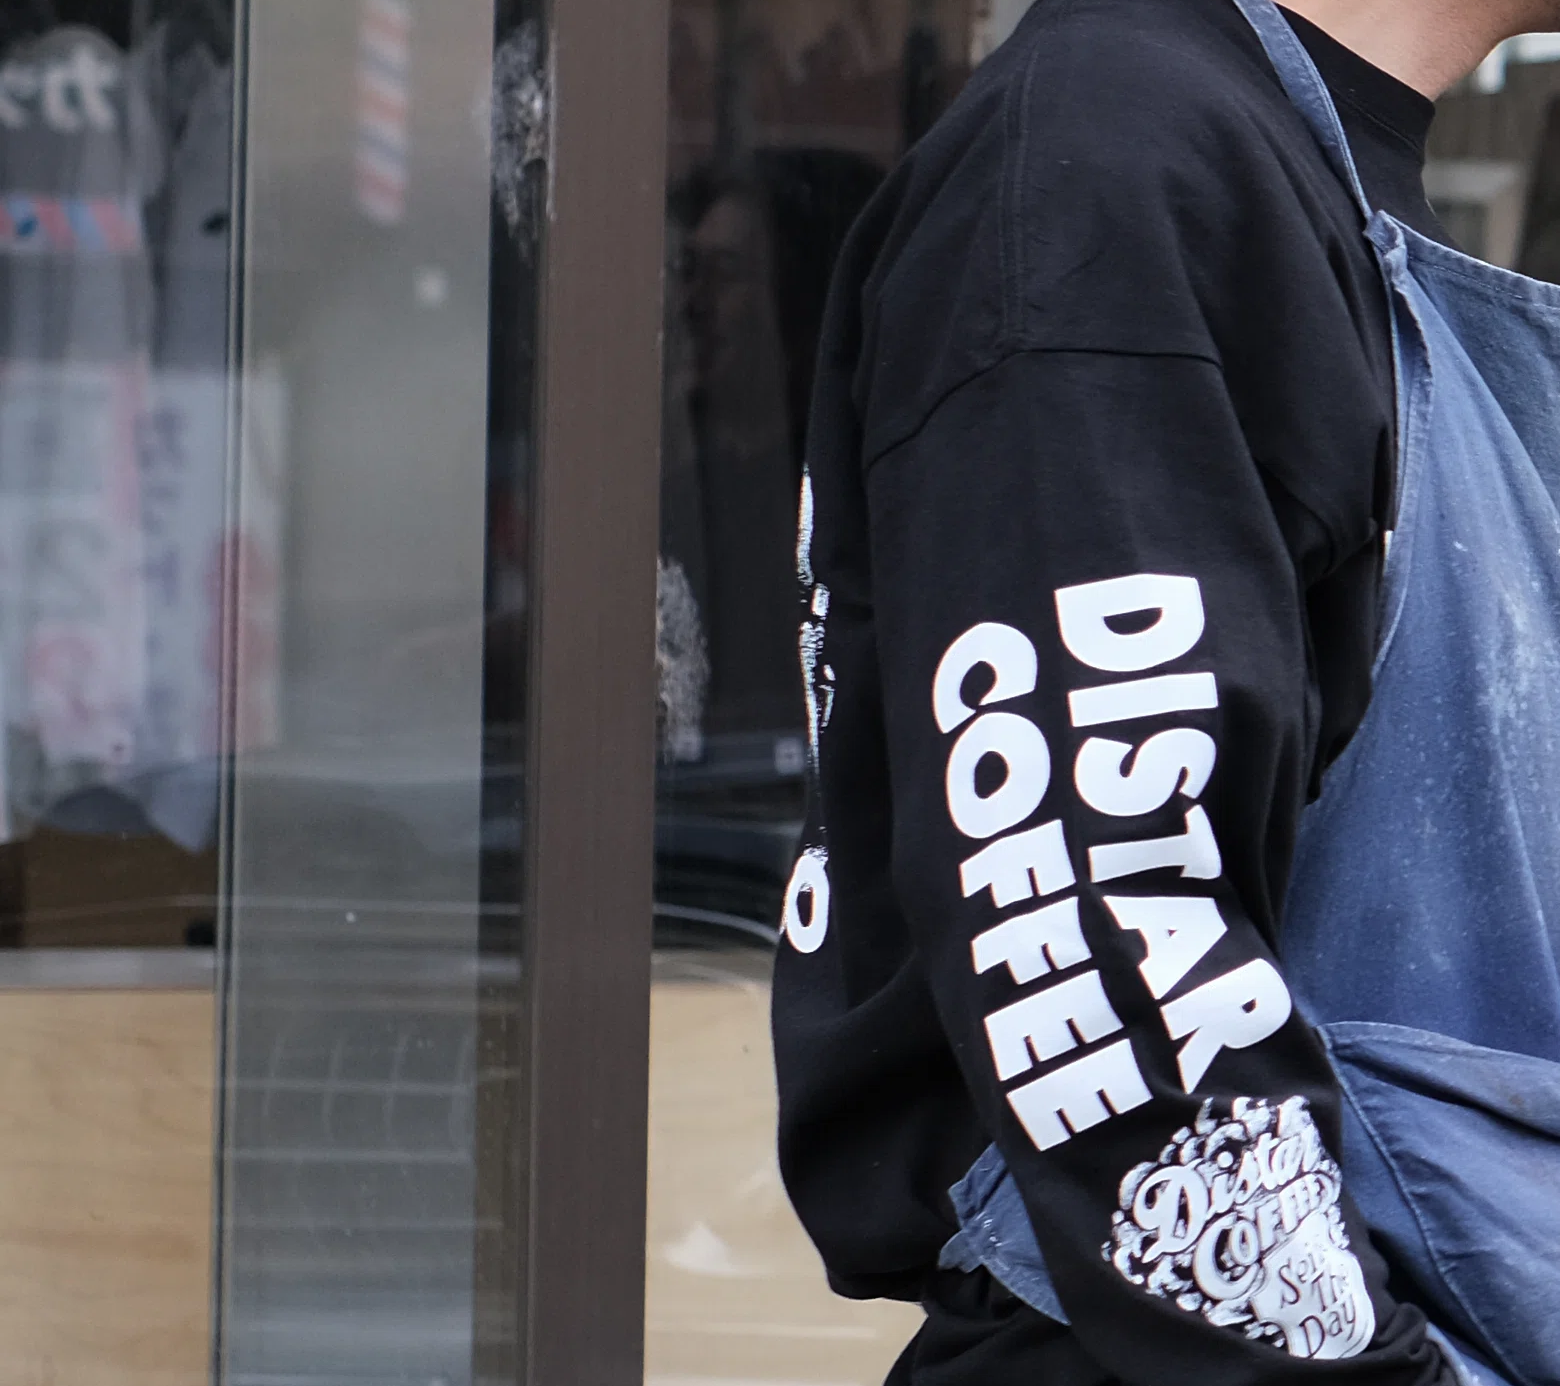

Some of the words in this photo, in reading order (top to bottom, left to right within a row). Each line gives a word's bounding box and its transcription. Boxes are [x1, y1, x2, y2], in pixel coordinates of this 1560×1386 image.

[932, 621, 1153, 1152] COFFEE
[1053, 573, 1292, 1095] DISTAR
[1298, 1294, 1356, 1358] Day
